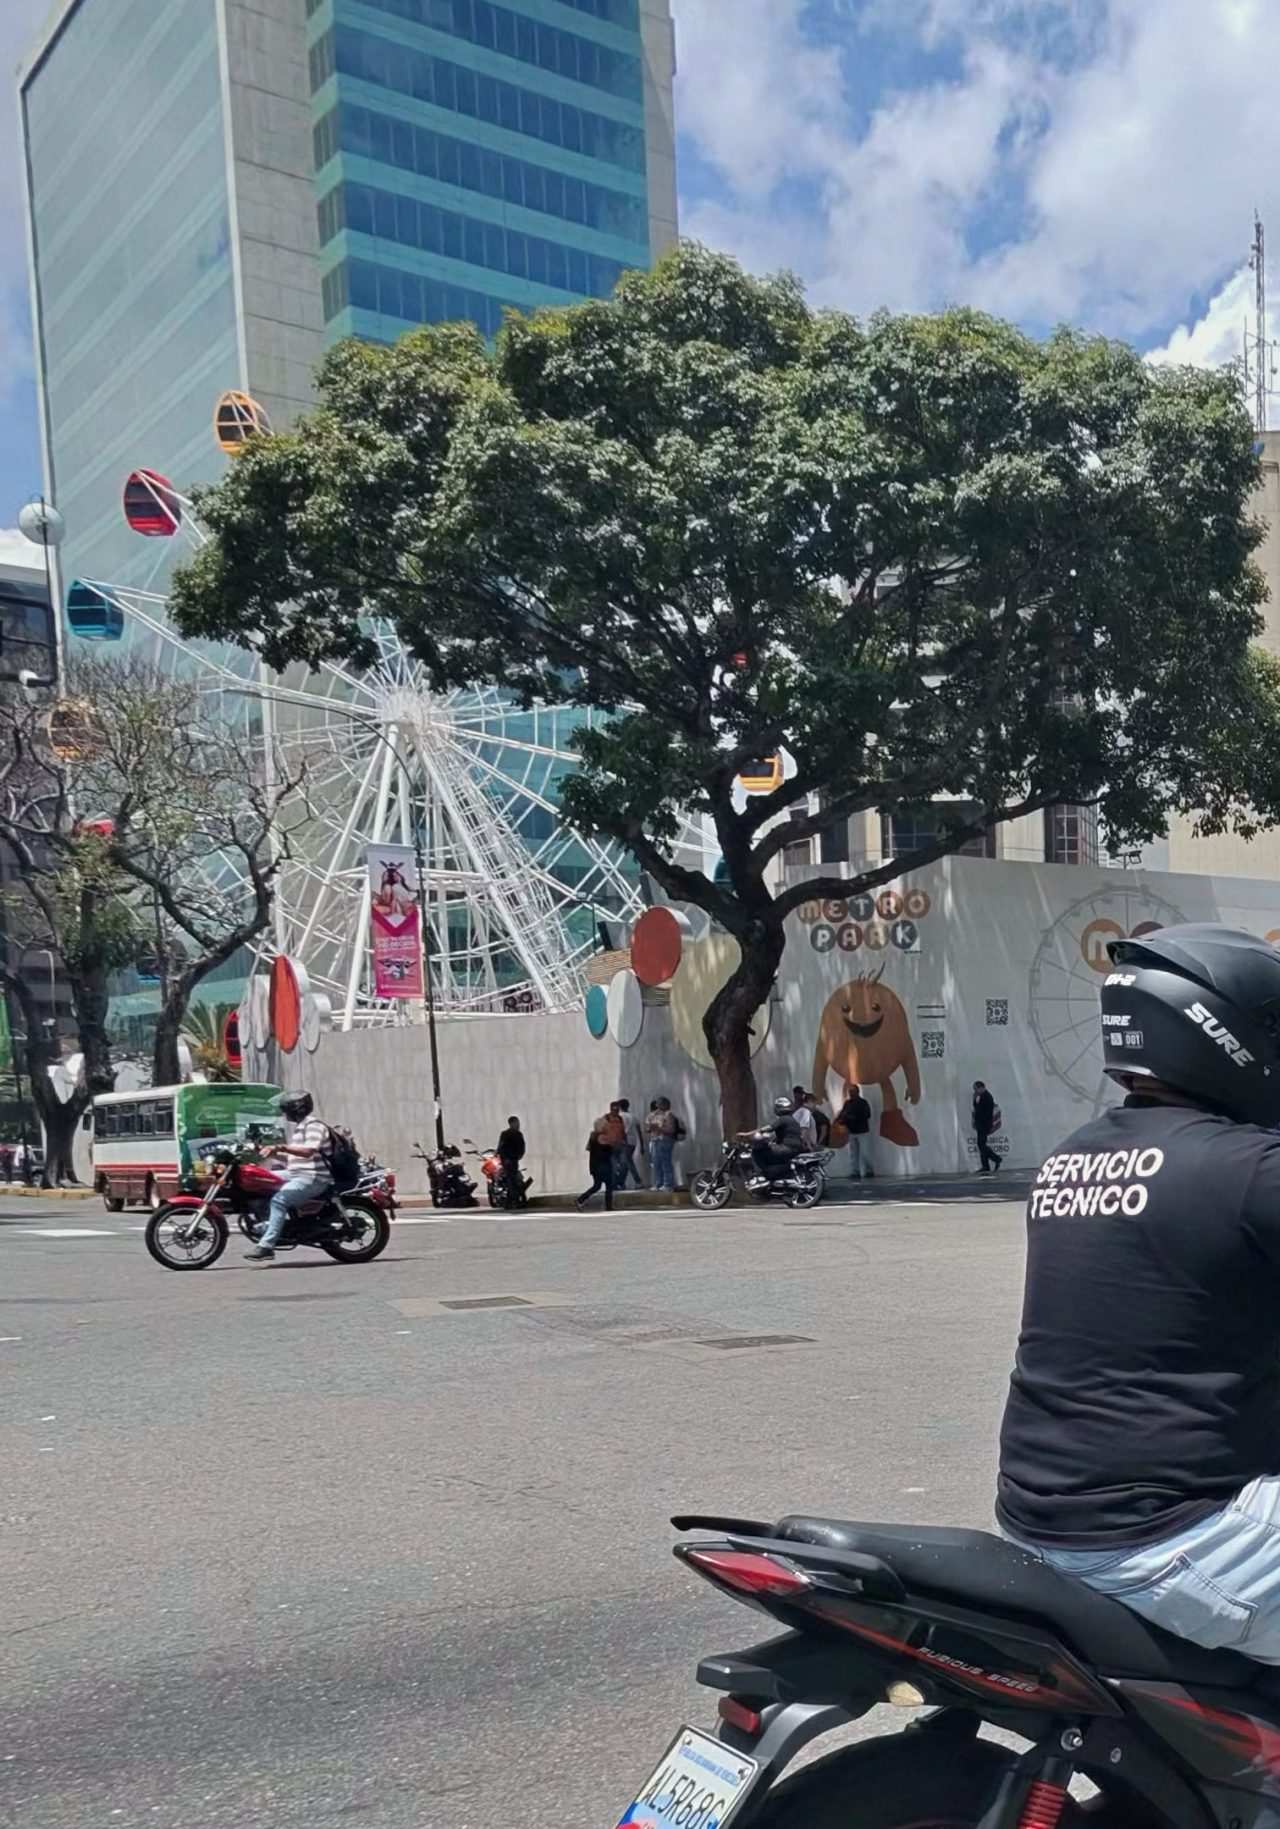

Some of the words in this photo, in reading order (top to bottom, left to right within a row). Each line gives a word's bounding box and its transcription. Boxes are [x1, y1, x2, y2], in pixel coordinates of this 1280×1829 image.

[800, 894, 925, 919] METRO
[816, 924, 913, 949] PARK
[1184, 1002, 1256, 1067] SURE
[1037, 1147, 1165, 1184] SERVICIO
[1031, 1182, 1148, 1219] TÉCNICO
[919, 1647, 984, 1675] FURIOUS
